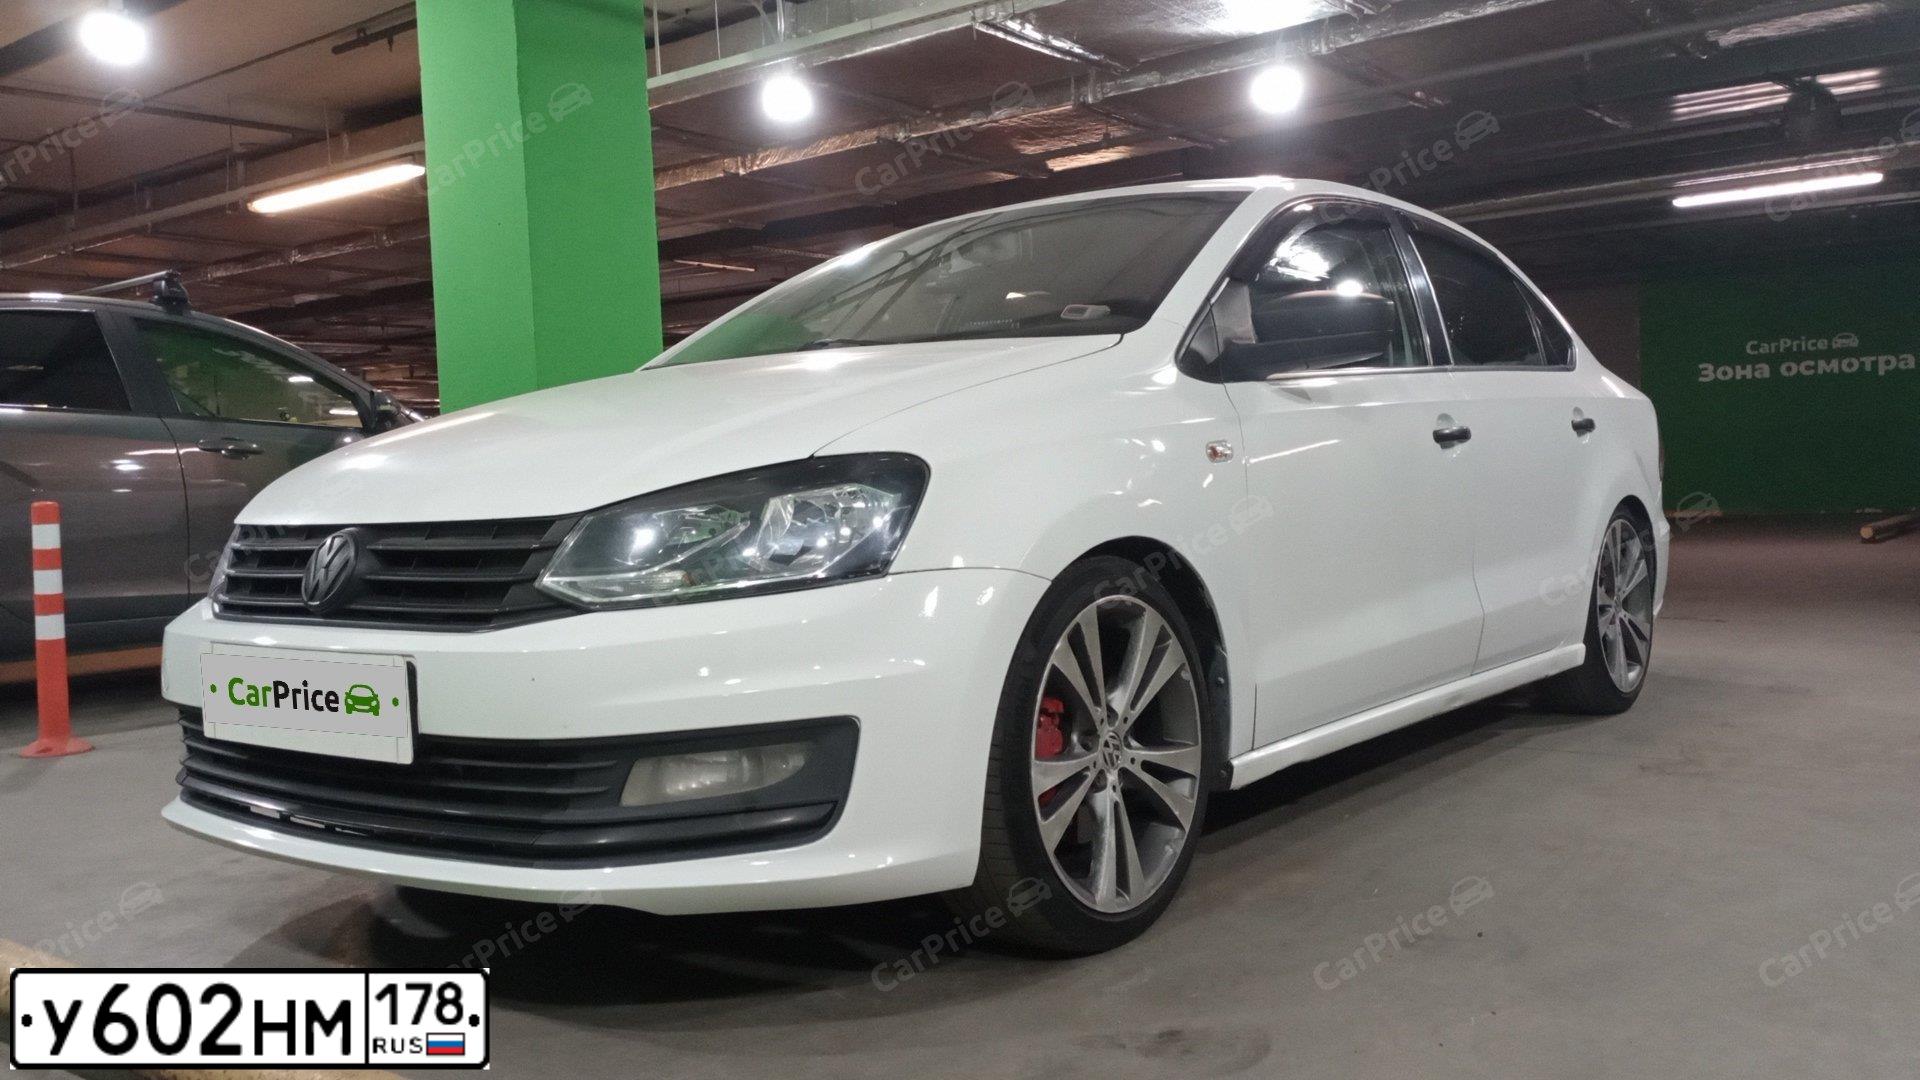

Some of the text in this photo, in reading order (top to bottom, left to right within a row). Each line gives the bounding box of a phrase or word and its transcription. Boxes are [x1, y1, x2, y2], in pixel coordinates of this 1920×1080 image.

[1746, 336, 1828, 355] CarPrice
[1698, 353, 1916, 382] Зона осмотра
